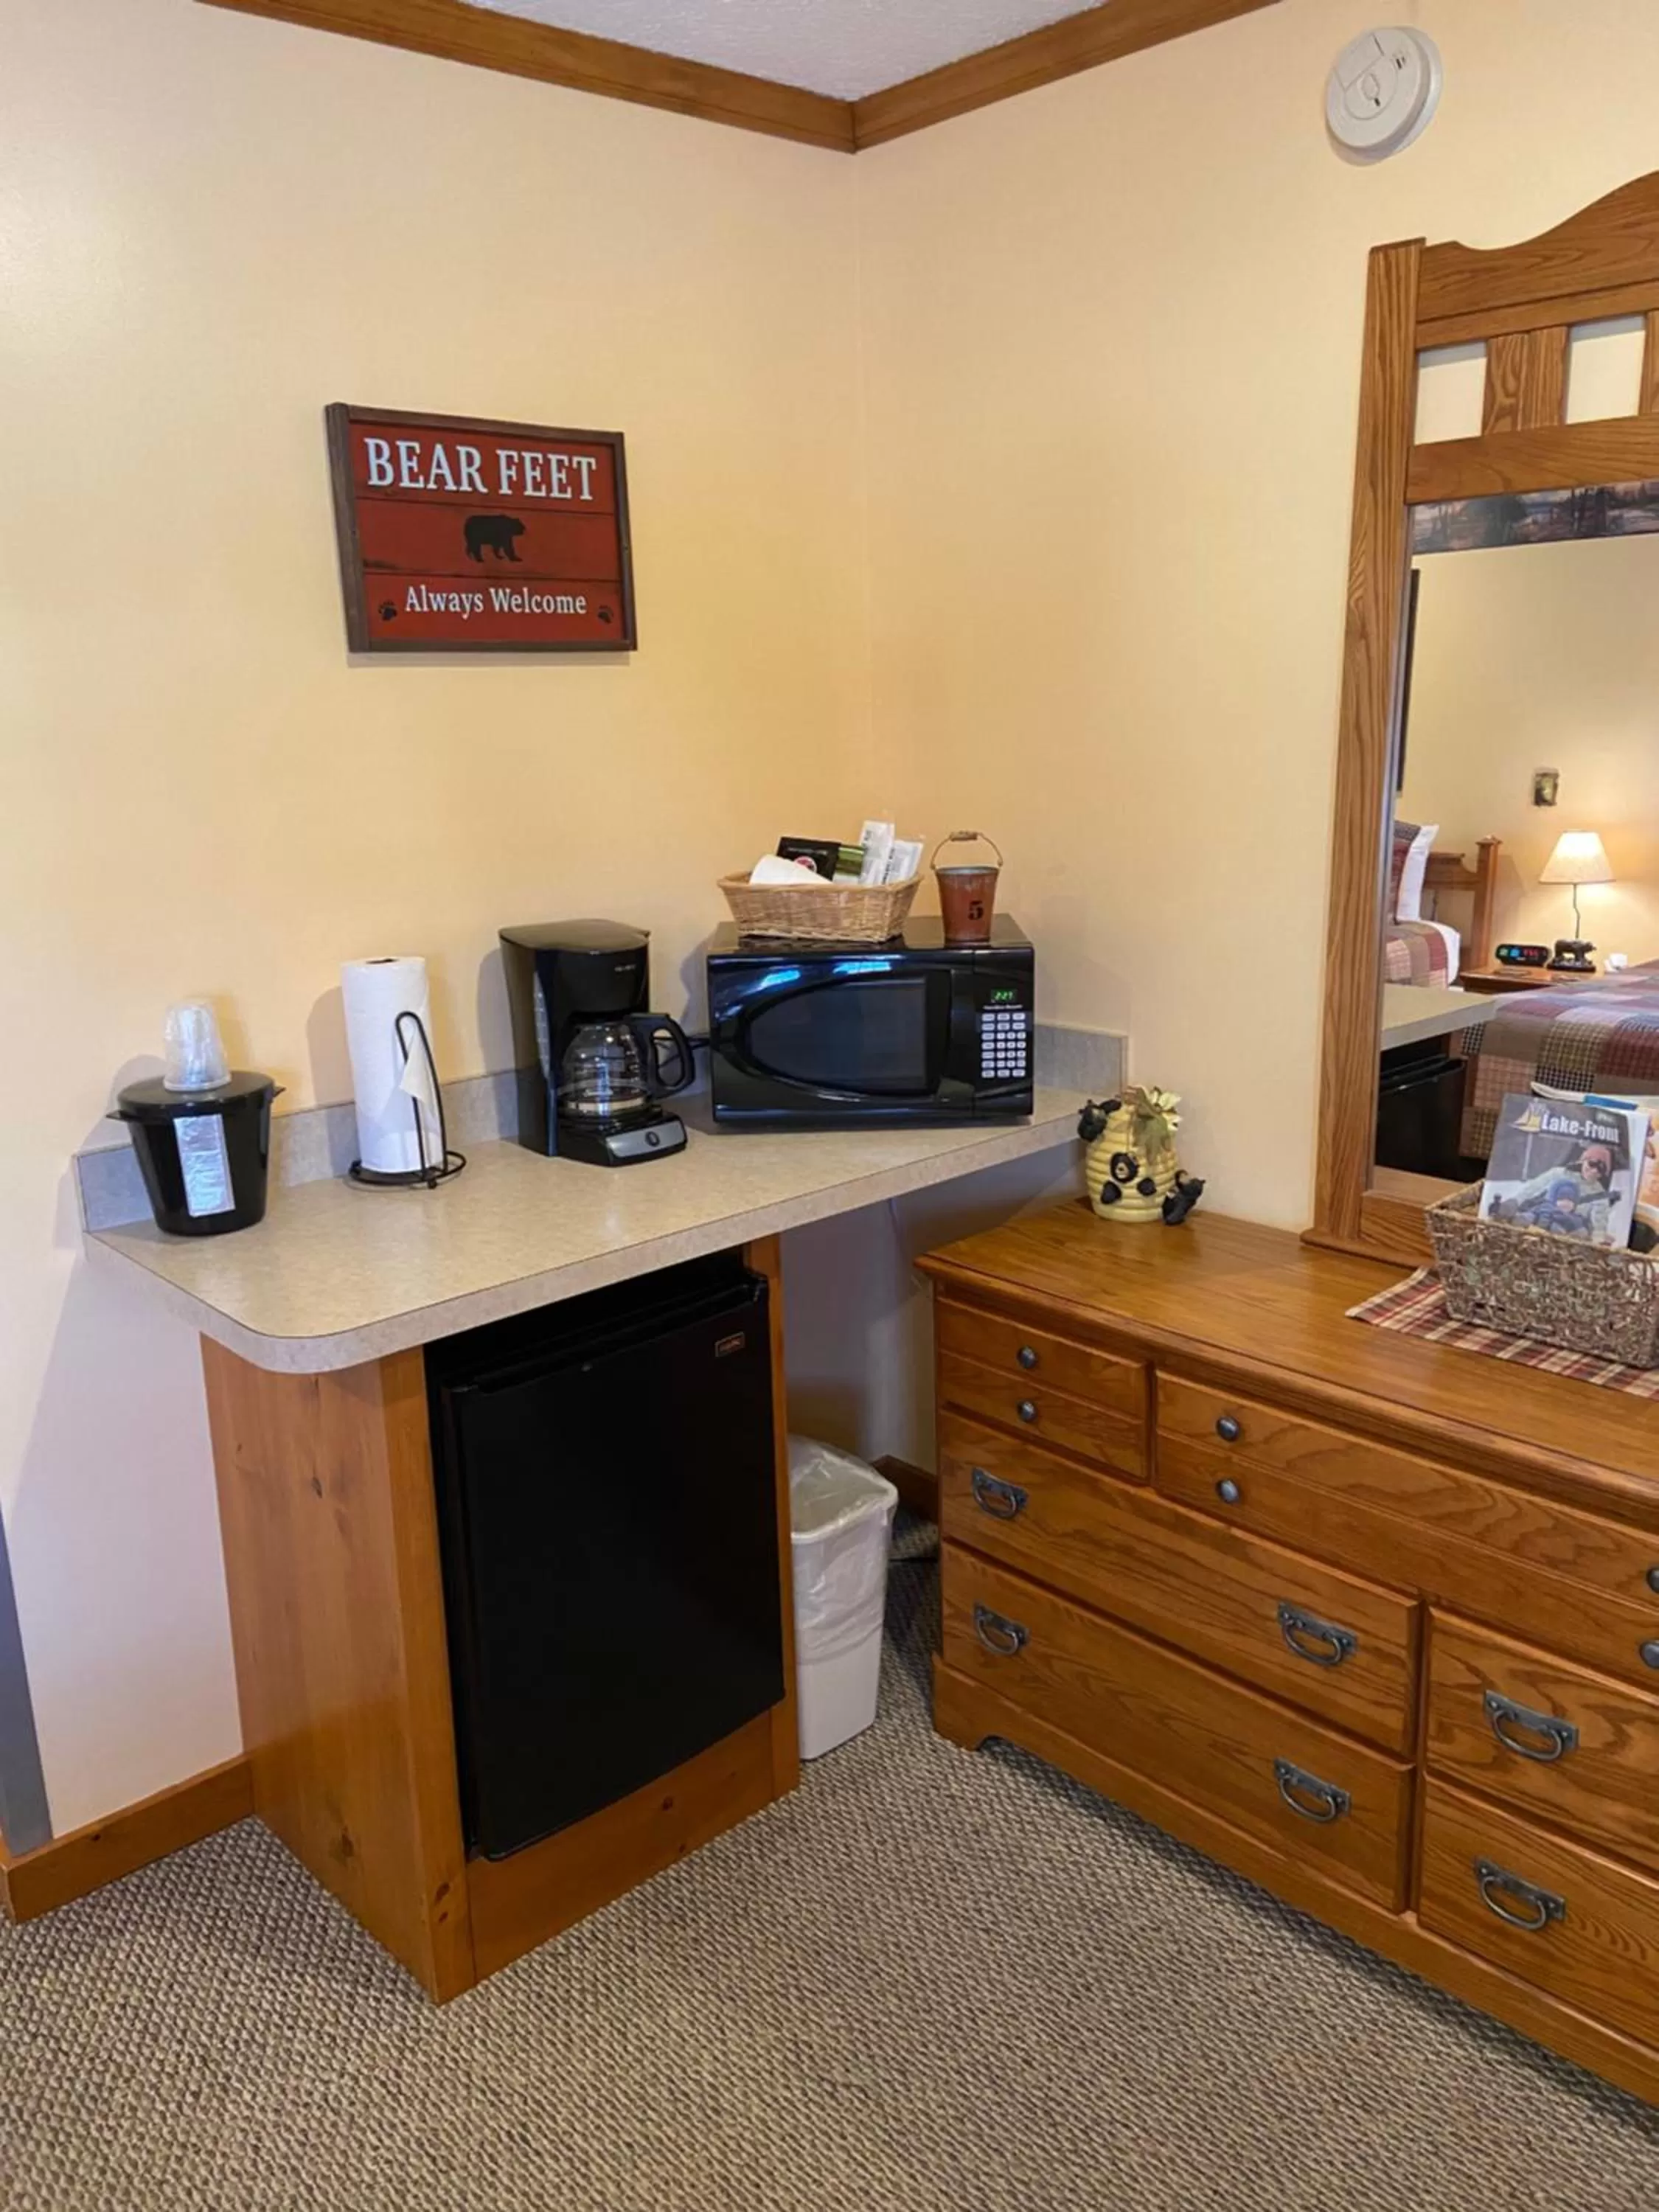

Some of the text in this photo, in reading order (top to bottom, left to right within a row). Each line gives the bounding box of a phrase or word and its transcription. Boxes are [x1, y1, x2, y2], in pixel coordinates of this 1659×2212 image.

[364, 437, 597, 500] BEAR FEET
[406, 585, 587, 619] Always Welcome
[967, 900, 984, 920] 5
